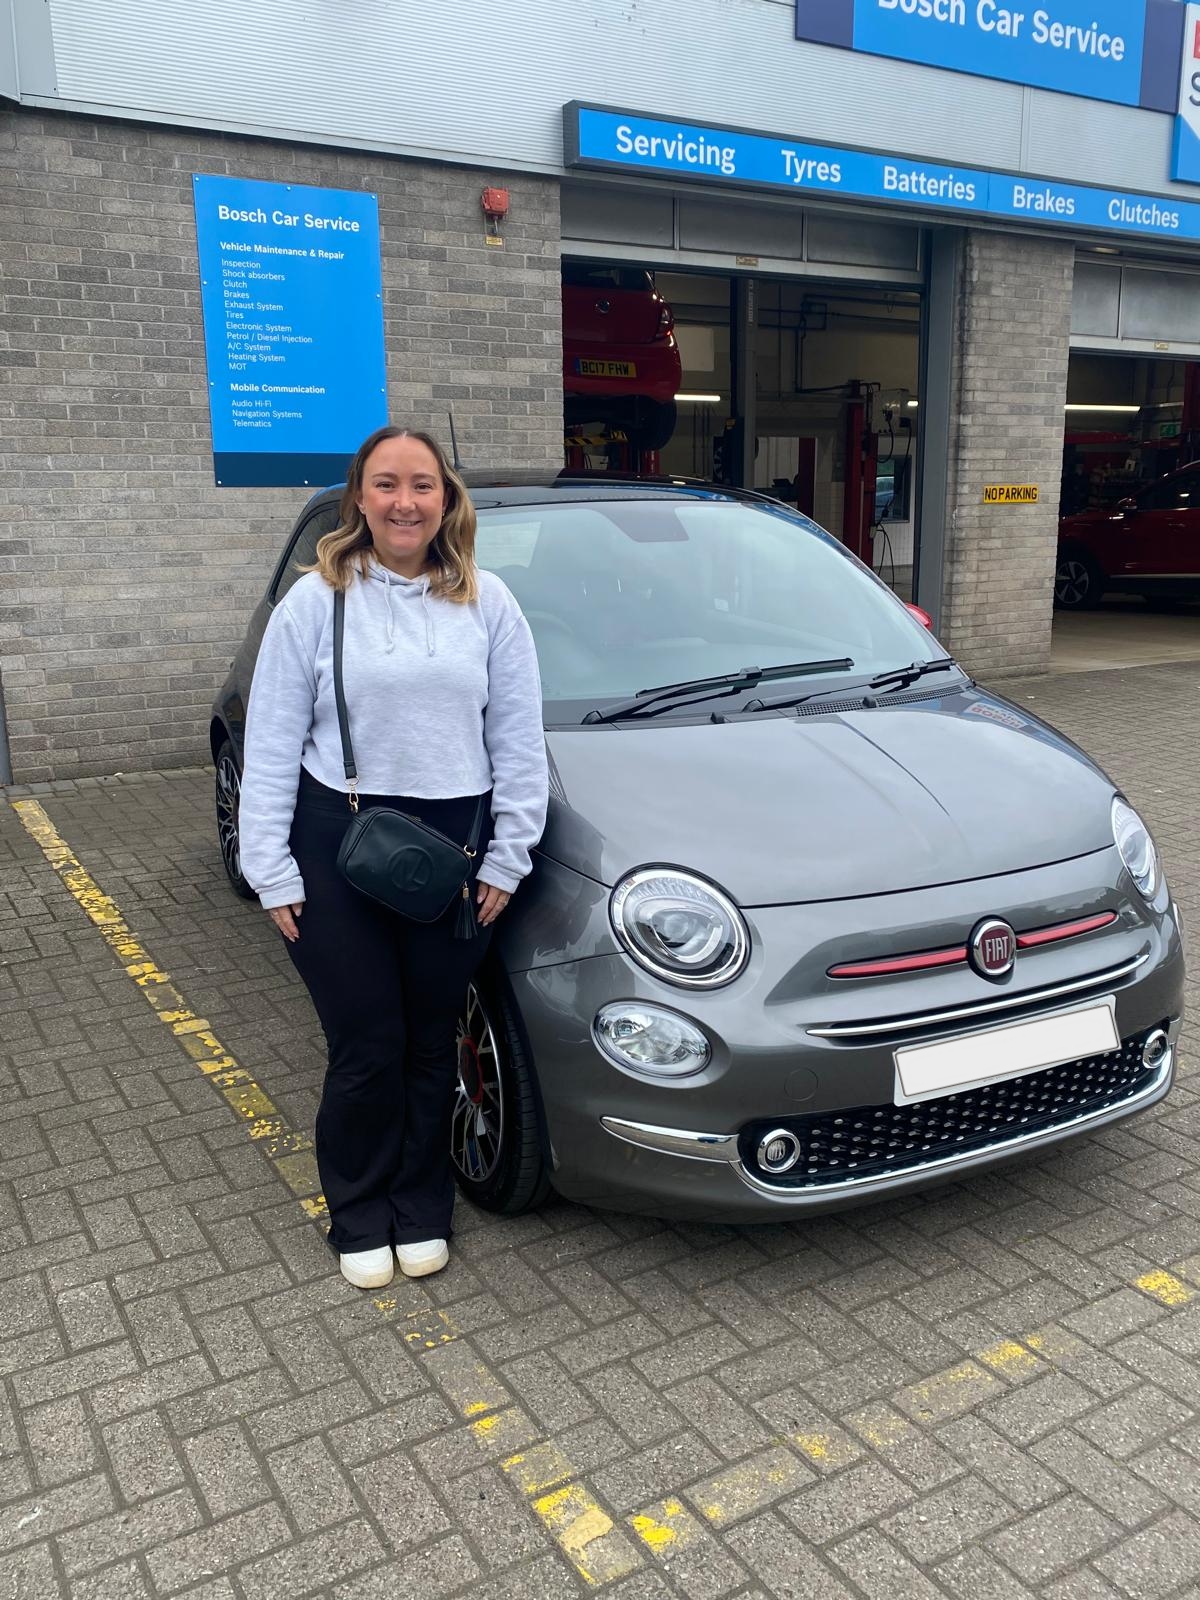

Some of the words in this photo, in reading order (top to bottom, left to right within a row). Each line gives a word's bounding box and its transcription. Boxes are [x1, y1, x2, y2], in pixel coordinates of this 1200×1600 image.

[878, 0, 966, 26] osch
[976, 0, 1024, 38] Car
[1032, 10, 1125, 61] Service
[616, 125, 736, 175] Servicing
[781, 149, 842, 183] Tyres
[883, 165, 976, 201] Batteries
[1012, 185, 1075, 215] Brakes
[1107, 199, 1179, 228] Clutches
[218, 205, 267, 224] Bosch
[272, 210, 300, 227] Car
[304, 213, 360, 232] Service
[219, 241, 252, 252] Vehicle
[254, 244, 308, 257] Maintenance
[309, 249, 316, 257] &
[318, 250, 345, 260] Repair
[221, 259, 261, 269] Inspection
[222, 269, 246, 278] Shock
[248, 271, 286, 281] absorbers
[223, 279, 248, 289] Clutch
[223, 290, 250, 299] Brakes
[224, 300, 254, 310] Exhaust
[256, 302, 284, 312] System
[225, 311, 244, 319] Tires
[226, 321, 263, 331] Electronic
[265, 324, 292, 333] System
[226, 332, 249, 340] Petrol
[257, 333, 280, 342] Diesel
[281, 334, 313, 343] Injection
[227, 342, 242, 350] A/C
[244, 343, 271, 352] System
[228, 352, 257, 362] Heating
[258, 353, 286, 363] System
[228, 362, 247, 371] MOT
[230, 383, 260, 392] Mobile
[261, 384, 326, 394] Communication
[231, 399, 253, 408] Audio
[254, 399, 272, 407] Hi-Fi
[232, 409, 270, 418] Navigation
[272, 410, 303, 419] Systems
[233, 419, 272, 428] Telematics
[984, 936, 1008, 963] FIAT
